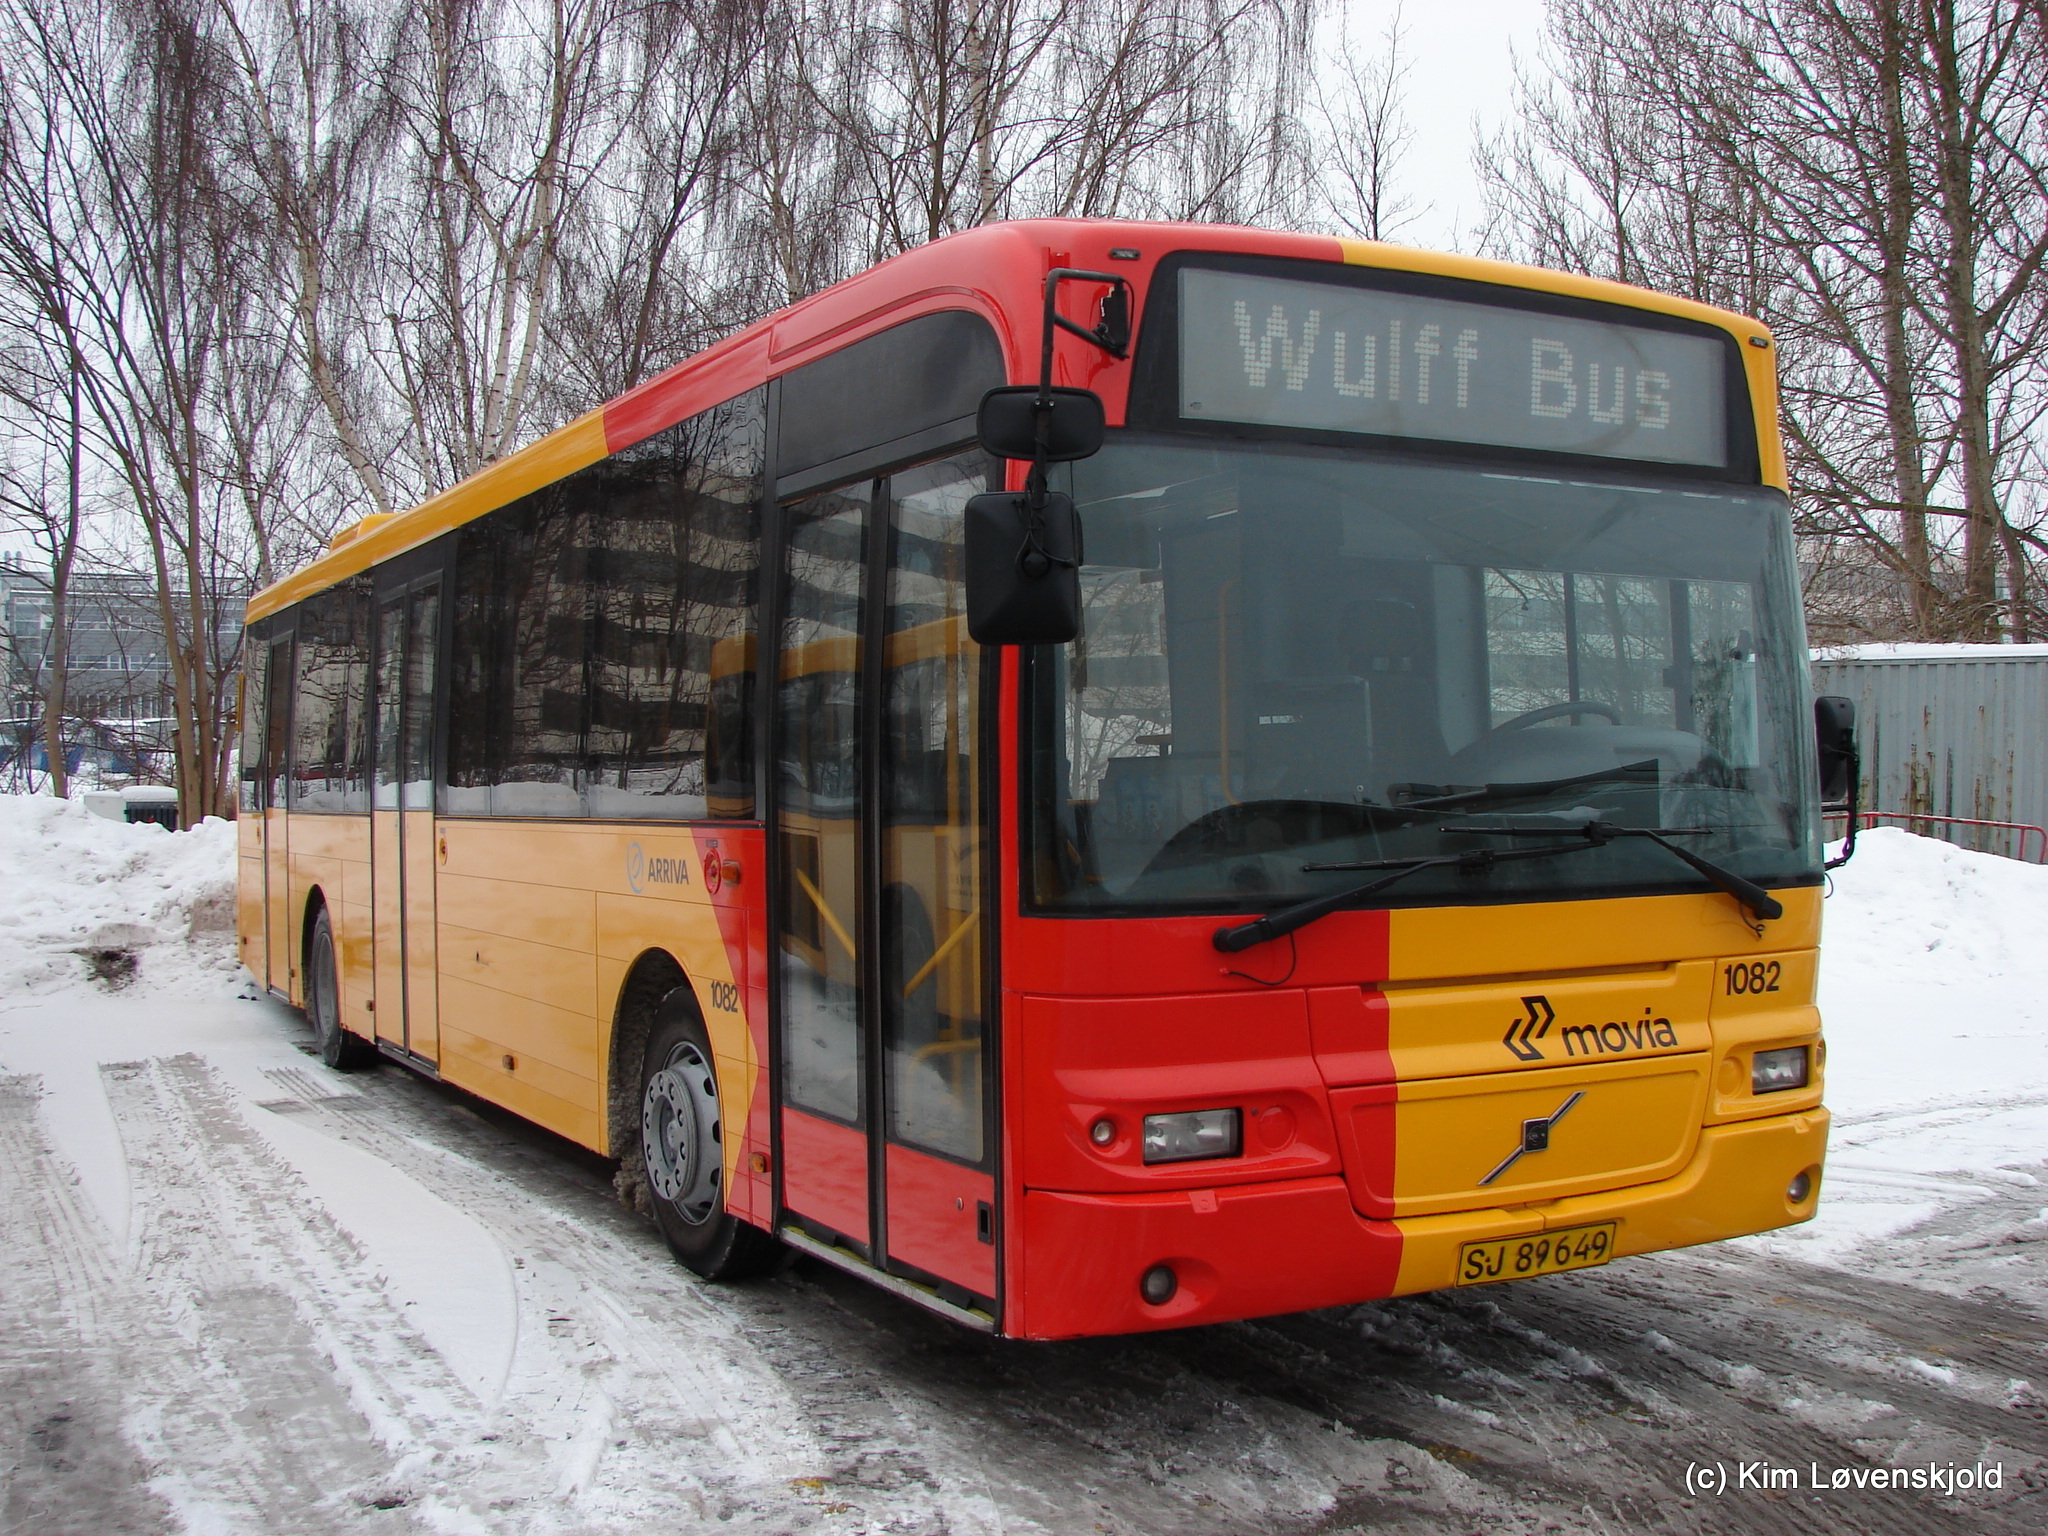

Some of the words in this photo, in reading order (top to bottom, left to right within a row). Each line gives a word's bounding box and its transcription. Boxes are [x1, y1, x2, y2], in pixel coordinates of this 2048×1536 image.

[1234, 300, 1478, 408] Wulff
[1531, 338, 1671, 429] Bus
[648, 857, 690, 885] ARRIVA
[1723, 960, 1782, 996] 1082
[710, 980, 739, 1014] 1082
[1561, 1007, 1678, 1056] movia
[1464, 1245, 1505, 1280] SJ
